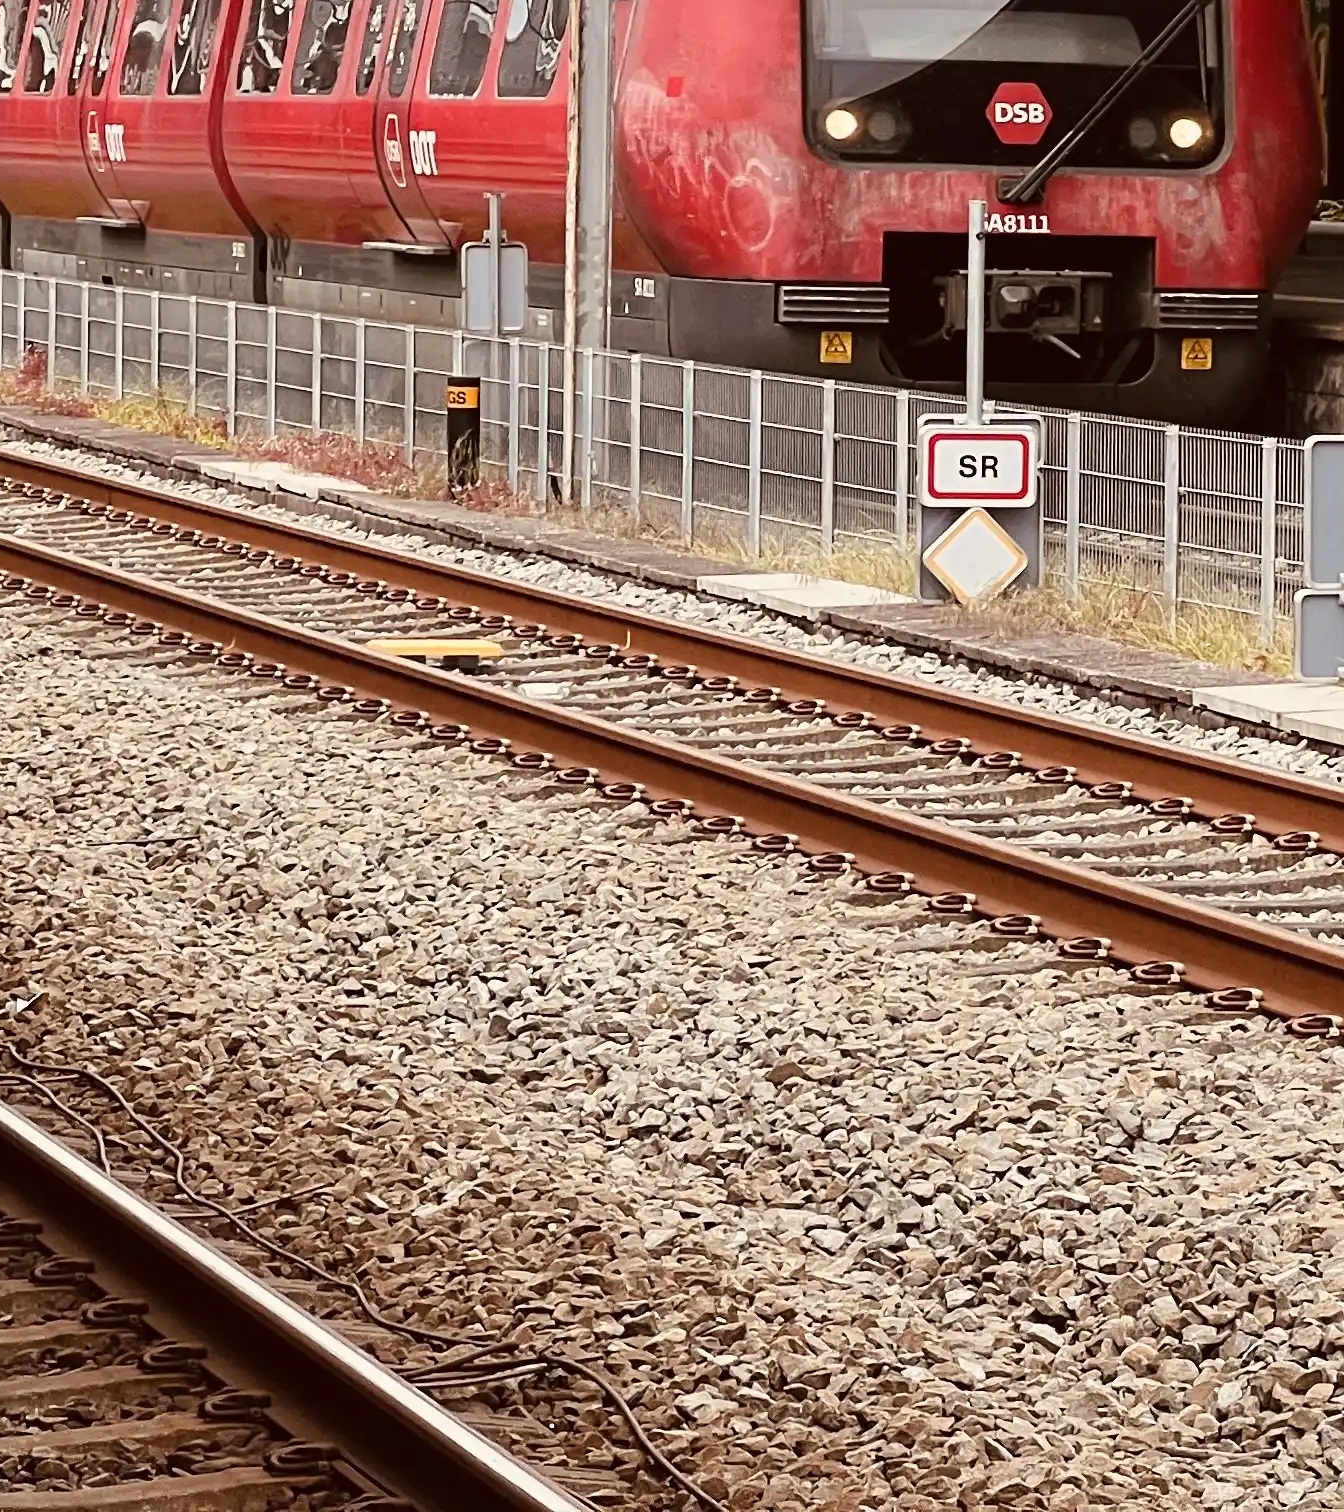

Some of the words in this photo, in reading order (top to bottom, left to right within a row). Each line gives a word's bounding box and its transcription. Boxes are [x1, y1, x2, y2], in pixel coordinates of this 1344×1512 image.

[994, 102, 1045, 124] DSB
[447, 390, 467, 405] GS
[958, 454, 999, 478] SR
